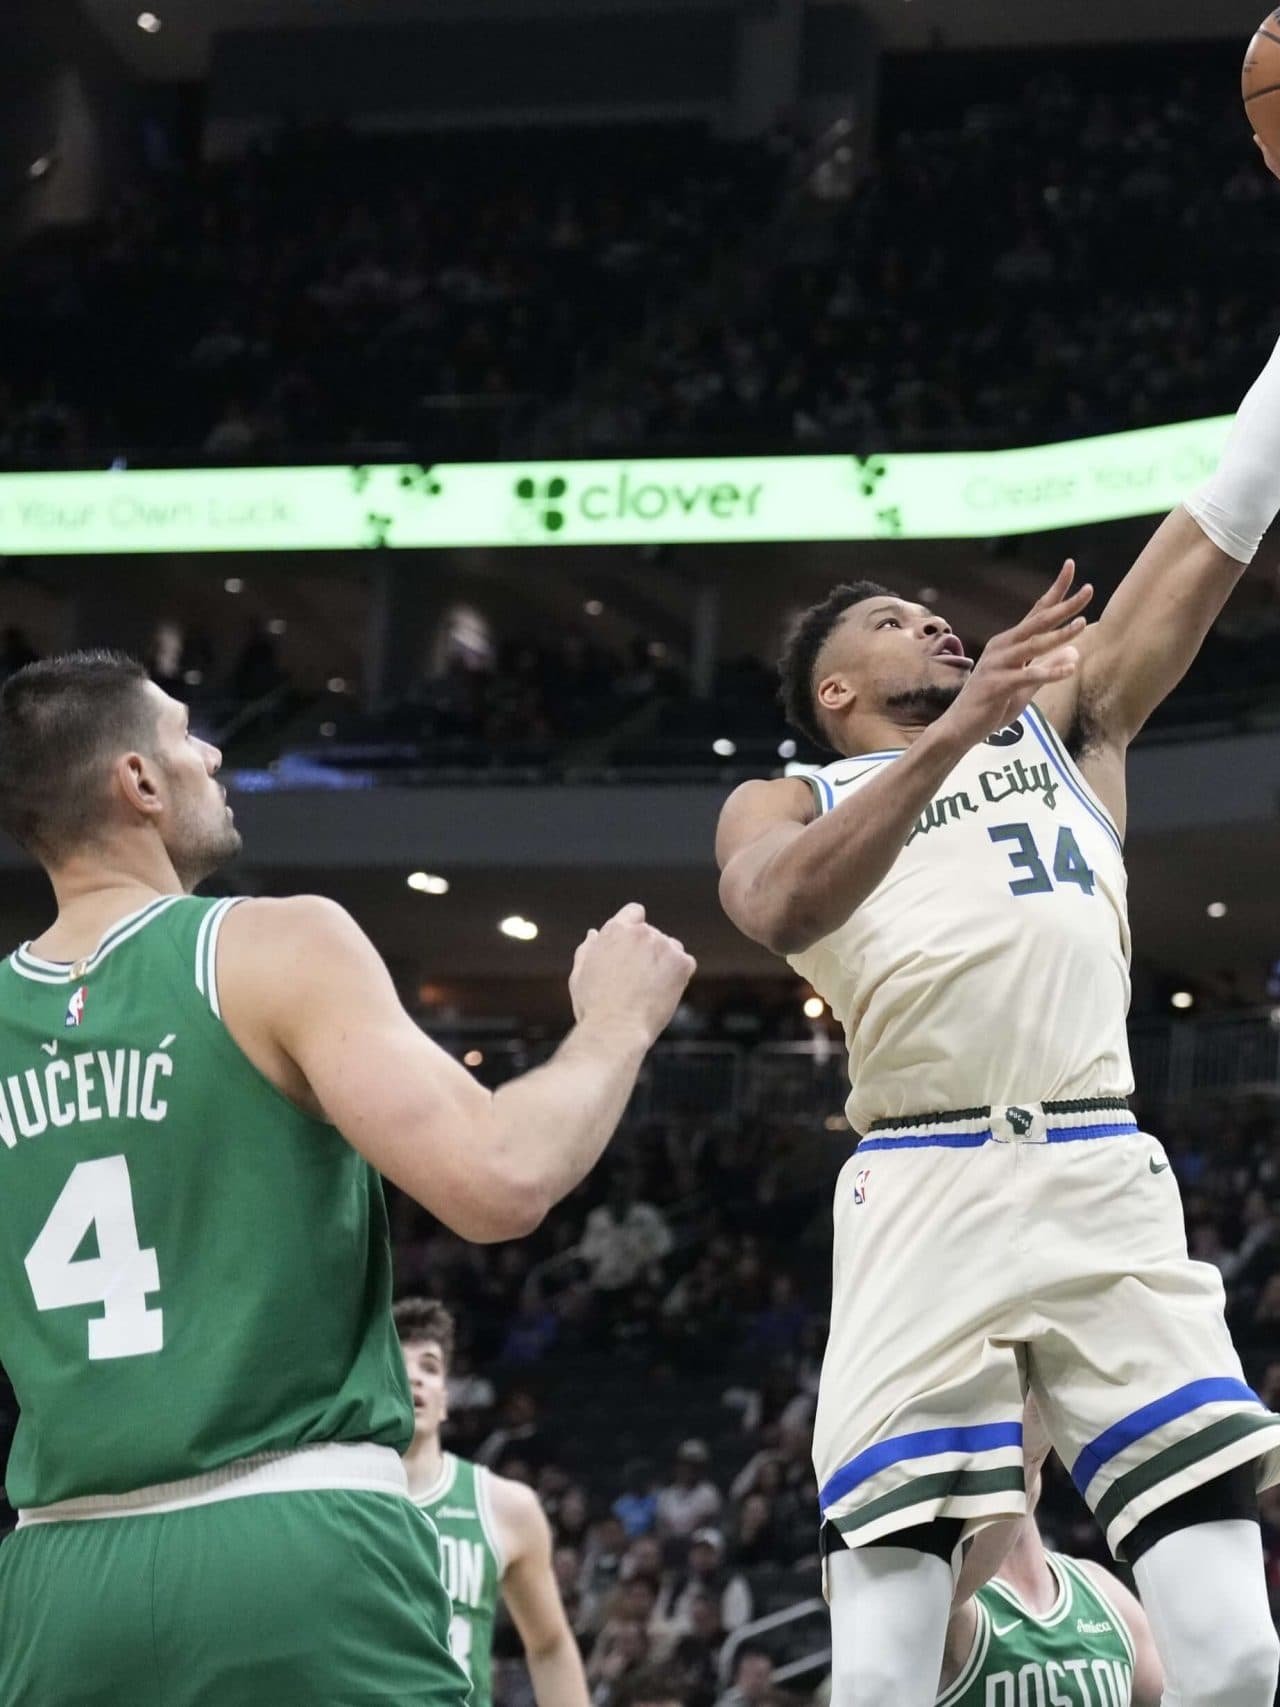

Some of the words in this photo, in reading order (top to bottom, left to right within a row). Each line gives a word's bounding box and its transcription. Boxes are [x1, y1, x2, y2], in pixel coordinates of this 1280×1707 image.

[578, 473, 763, 520] clover
[979, 759, 1058, 810] City
[988, 823, 1094, 896] 34
[24, 1154, 163, 1360] 4
